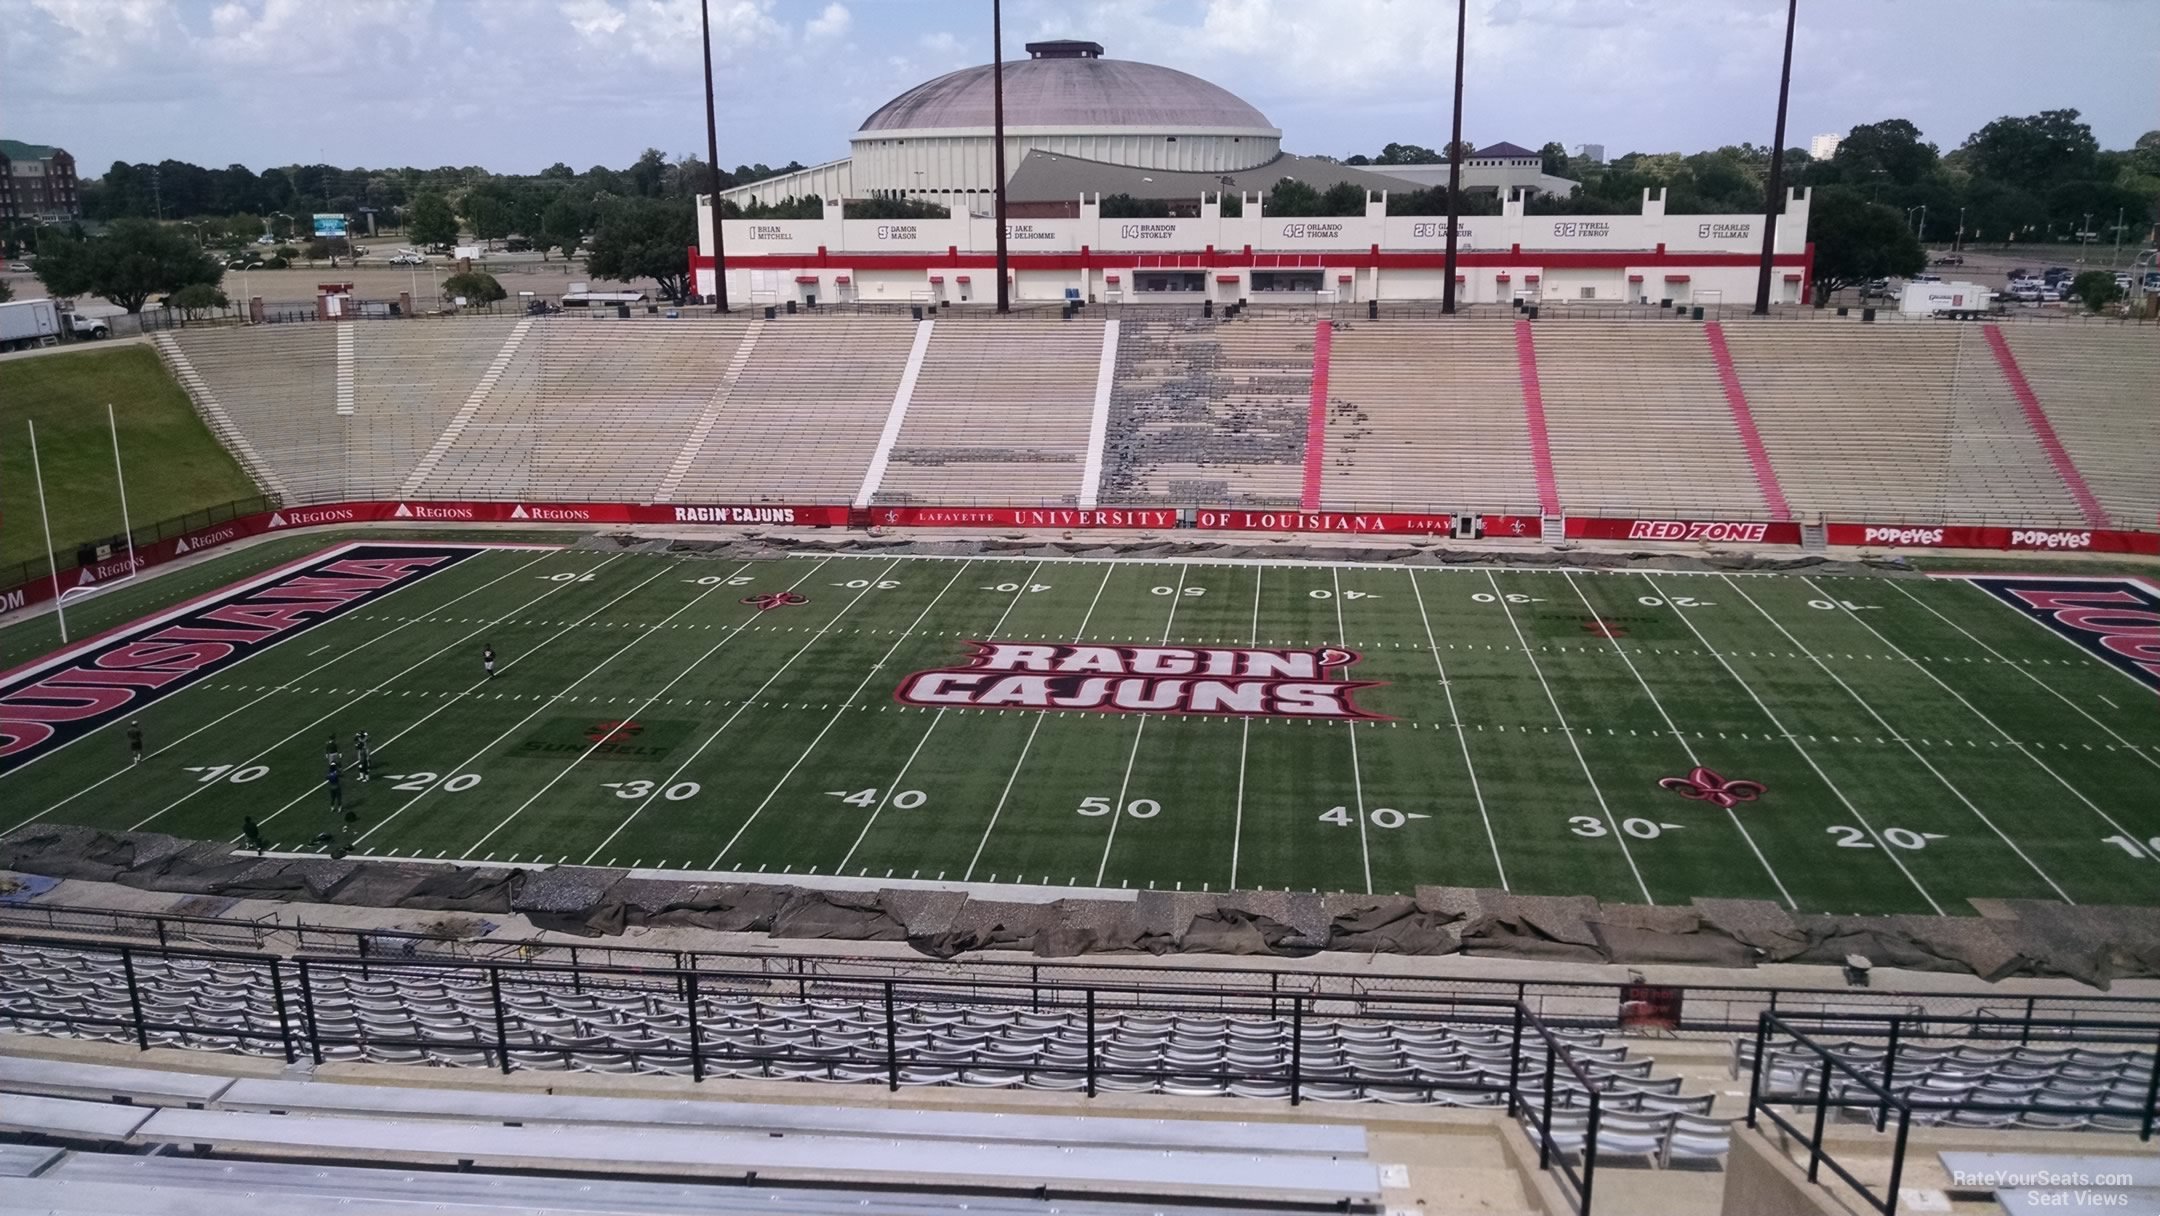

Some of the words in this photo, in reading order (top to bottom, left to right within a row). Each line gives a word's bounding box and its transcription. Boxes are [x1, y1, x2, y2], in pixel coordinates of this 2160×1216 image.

[1121, 224, 1139, 239] 14
[1283, 224, 1306, 238] 42
[1413, 223, 1436, 237] 28
[1554, 222, 1577, 237] 32
[1578, 222, 1610, 230] TYRELL
[1699, 224, 1711, 238] 5
[1712, 231, 1749, 239] TILLMAN
[733, 508, 795, 523] CAJUNS
[919, 512, 994, 522] LAFAYETTE
[1014, 510, 1168, 525] UNIVERSITY
[1201, 512, 1231, 527] OF
[1245, 513, 1386, 531] LOUISIANA
[1628, 521, 1687, 540] RED
[1687, 522, 1768, 542] ZONE
[899, 671, 1372, 718] CAJUNS
[198, 764, 271, 784] 10
[391, 772, 482, 792] 20
[615, 780, 701, 801] 30
[842, 788, 928, 809] 40
[1077, 797, 1161, 819] 50
[1318, 806, 1406, 829] 40
[1568, 815, 1661, 839] 30
[1826, 825, 1928, 850] 20
